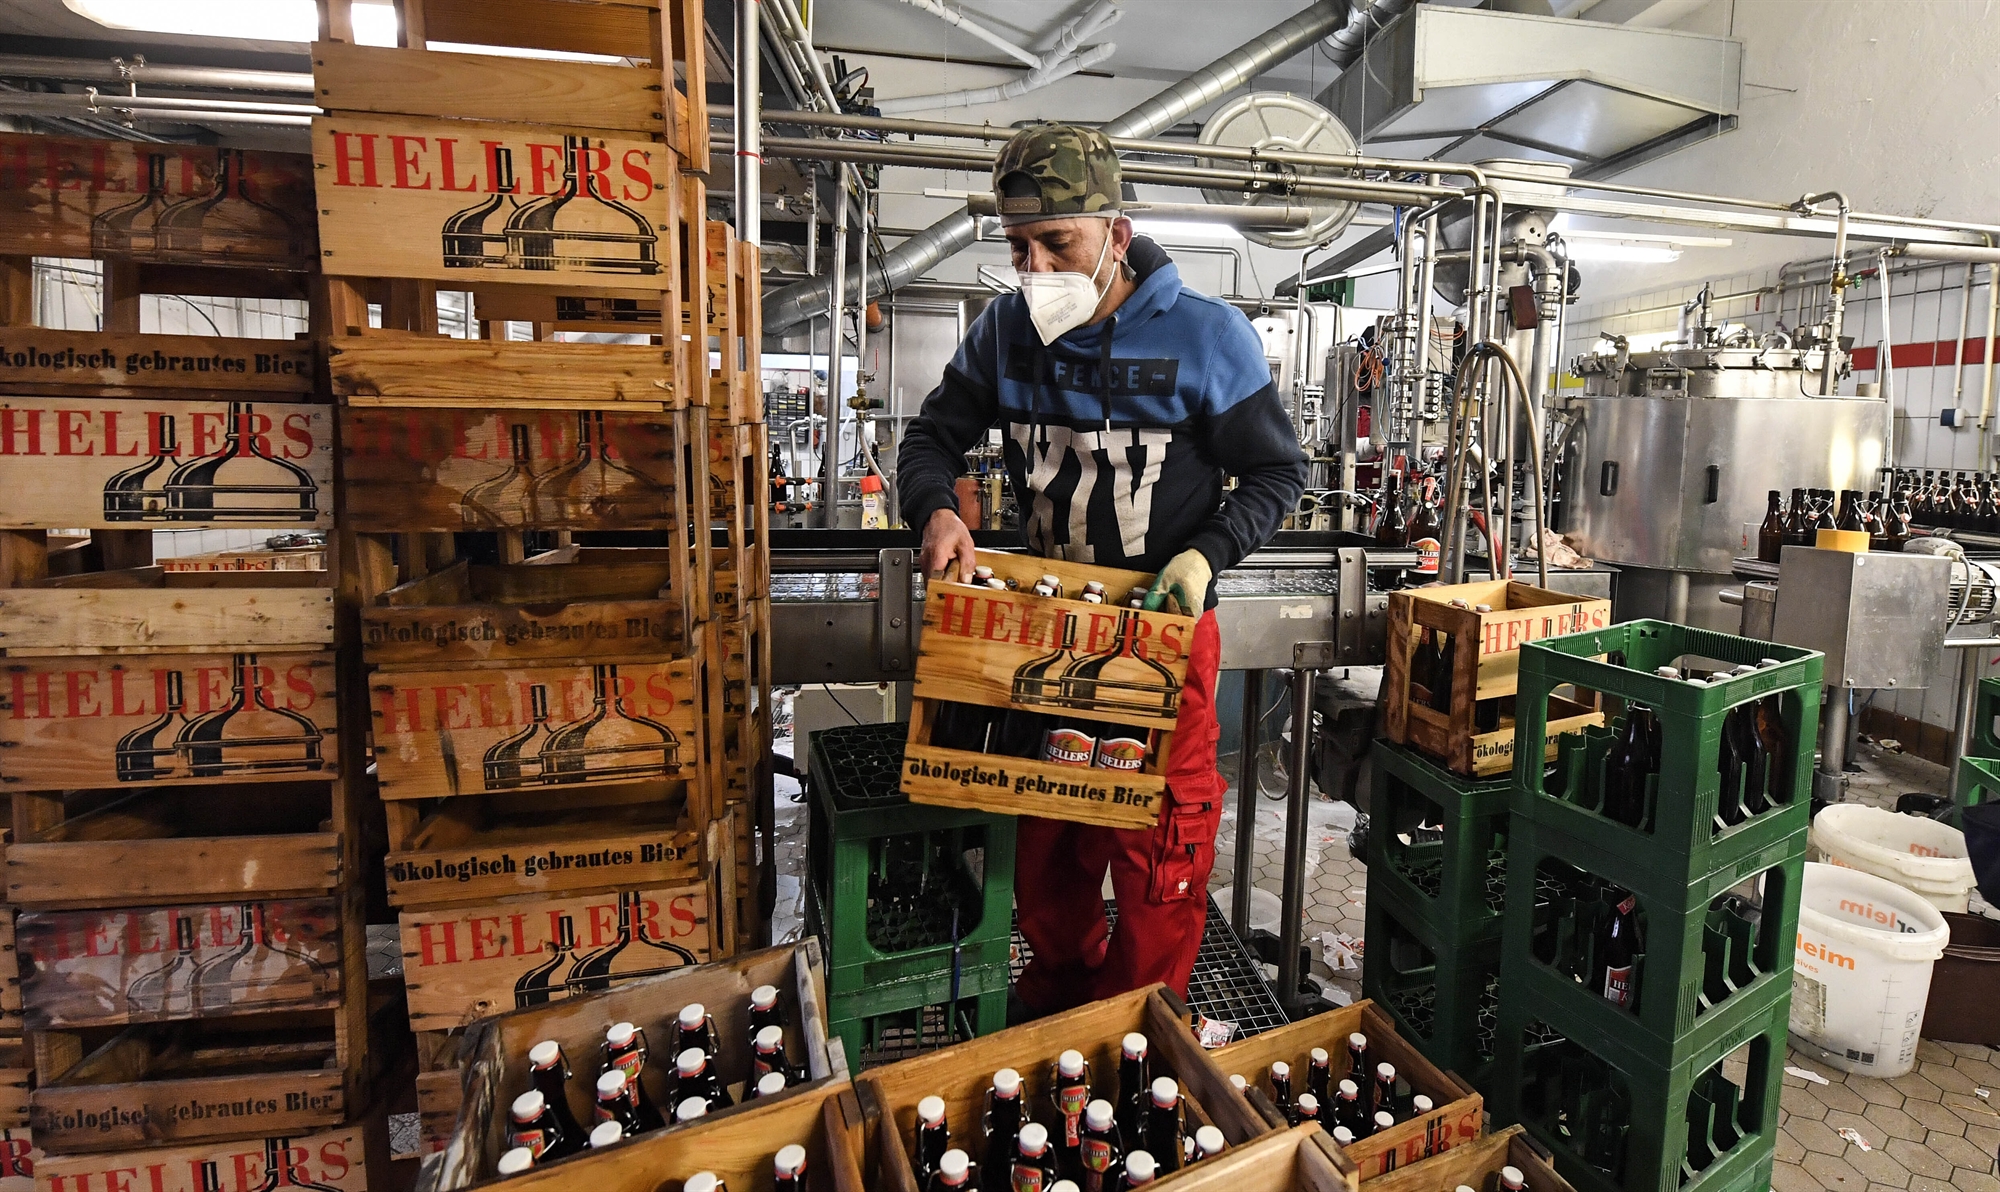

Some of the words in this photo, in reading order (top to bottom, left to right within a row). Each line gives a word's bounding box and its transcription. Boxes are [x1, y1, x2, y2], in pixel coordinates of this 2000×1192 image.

[333, 131, 655, 202] HELLERS
[0, 346, 117, 371] kologisch
[125, 350, 246, 375] gebrautes
[254, 353, 306, 374] Bier
[0, 408, 315, 459] HELLERS
[625, 616, 670, 640] Bie
[936, 592, 1185, 665] HELLERS
[1483, 609, 1603, 655] HELLERS
[9, 664, 317, 720] HELLERS
[380, 672, 675, 735] HELLERS
[1047, 744, 1089, 762] HELLERS
[1100, 753, 1142, 769] HELLERS
[1476, 738, 1514, 759] ökologi
[909, 757, 1009, 788] ökologisch
[1015, 774, 1106, 802] gebrautes
[1112, 785, 1154, 808] Bier
[394, 854, 516, 882] ökologisch
[524, 848, 633, 877] gebrautes
[639, 842, 688, 864] Bier
[419, 895, 698, 967] HELLERS
[168, 1095, 277, 1127] gebrautes
[285, 1091, 334, 1112] Bier
